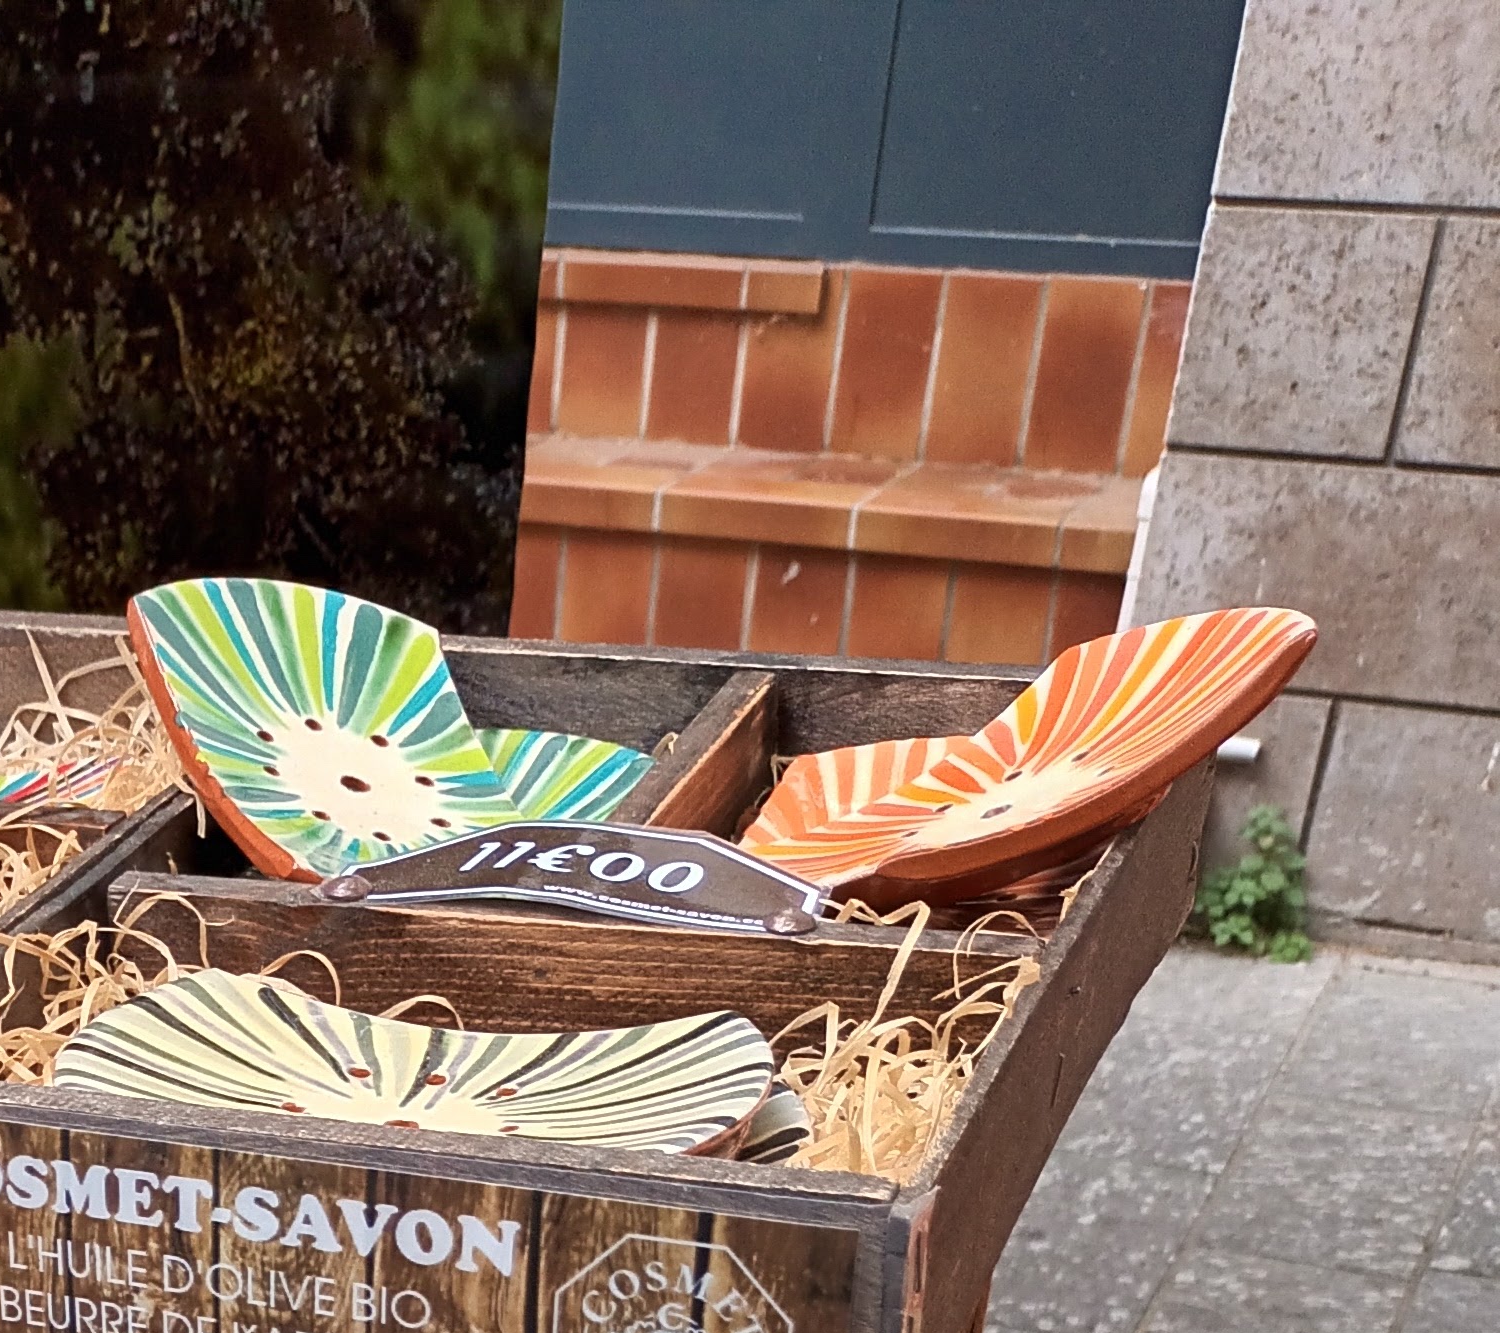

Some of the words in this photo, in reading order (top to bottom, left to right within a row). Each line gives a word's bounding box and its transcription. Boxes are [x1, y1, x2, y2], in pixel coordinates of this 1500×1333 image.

[459, 840, 704, 894] 11€00
[7, 1230, 149, 1290] L'HUILE
[162, 1253, 336, 1318] D'OLIVE
[351, 1282, 432, 1330] BIO
